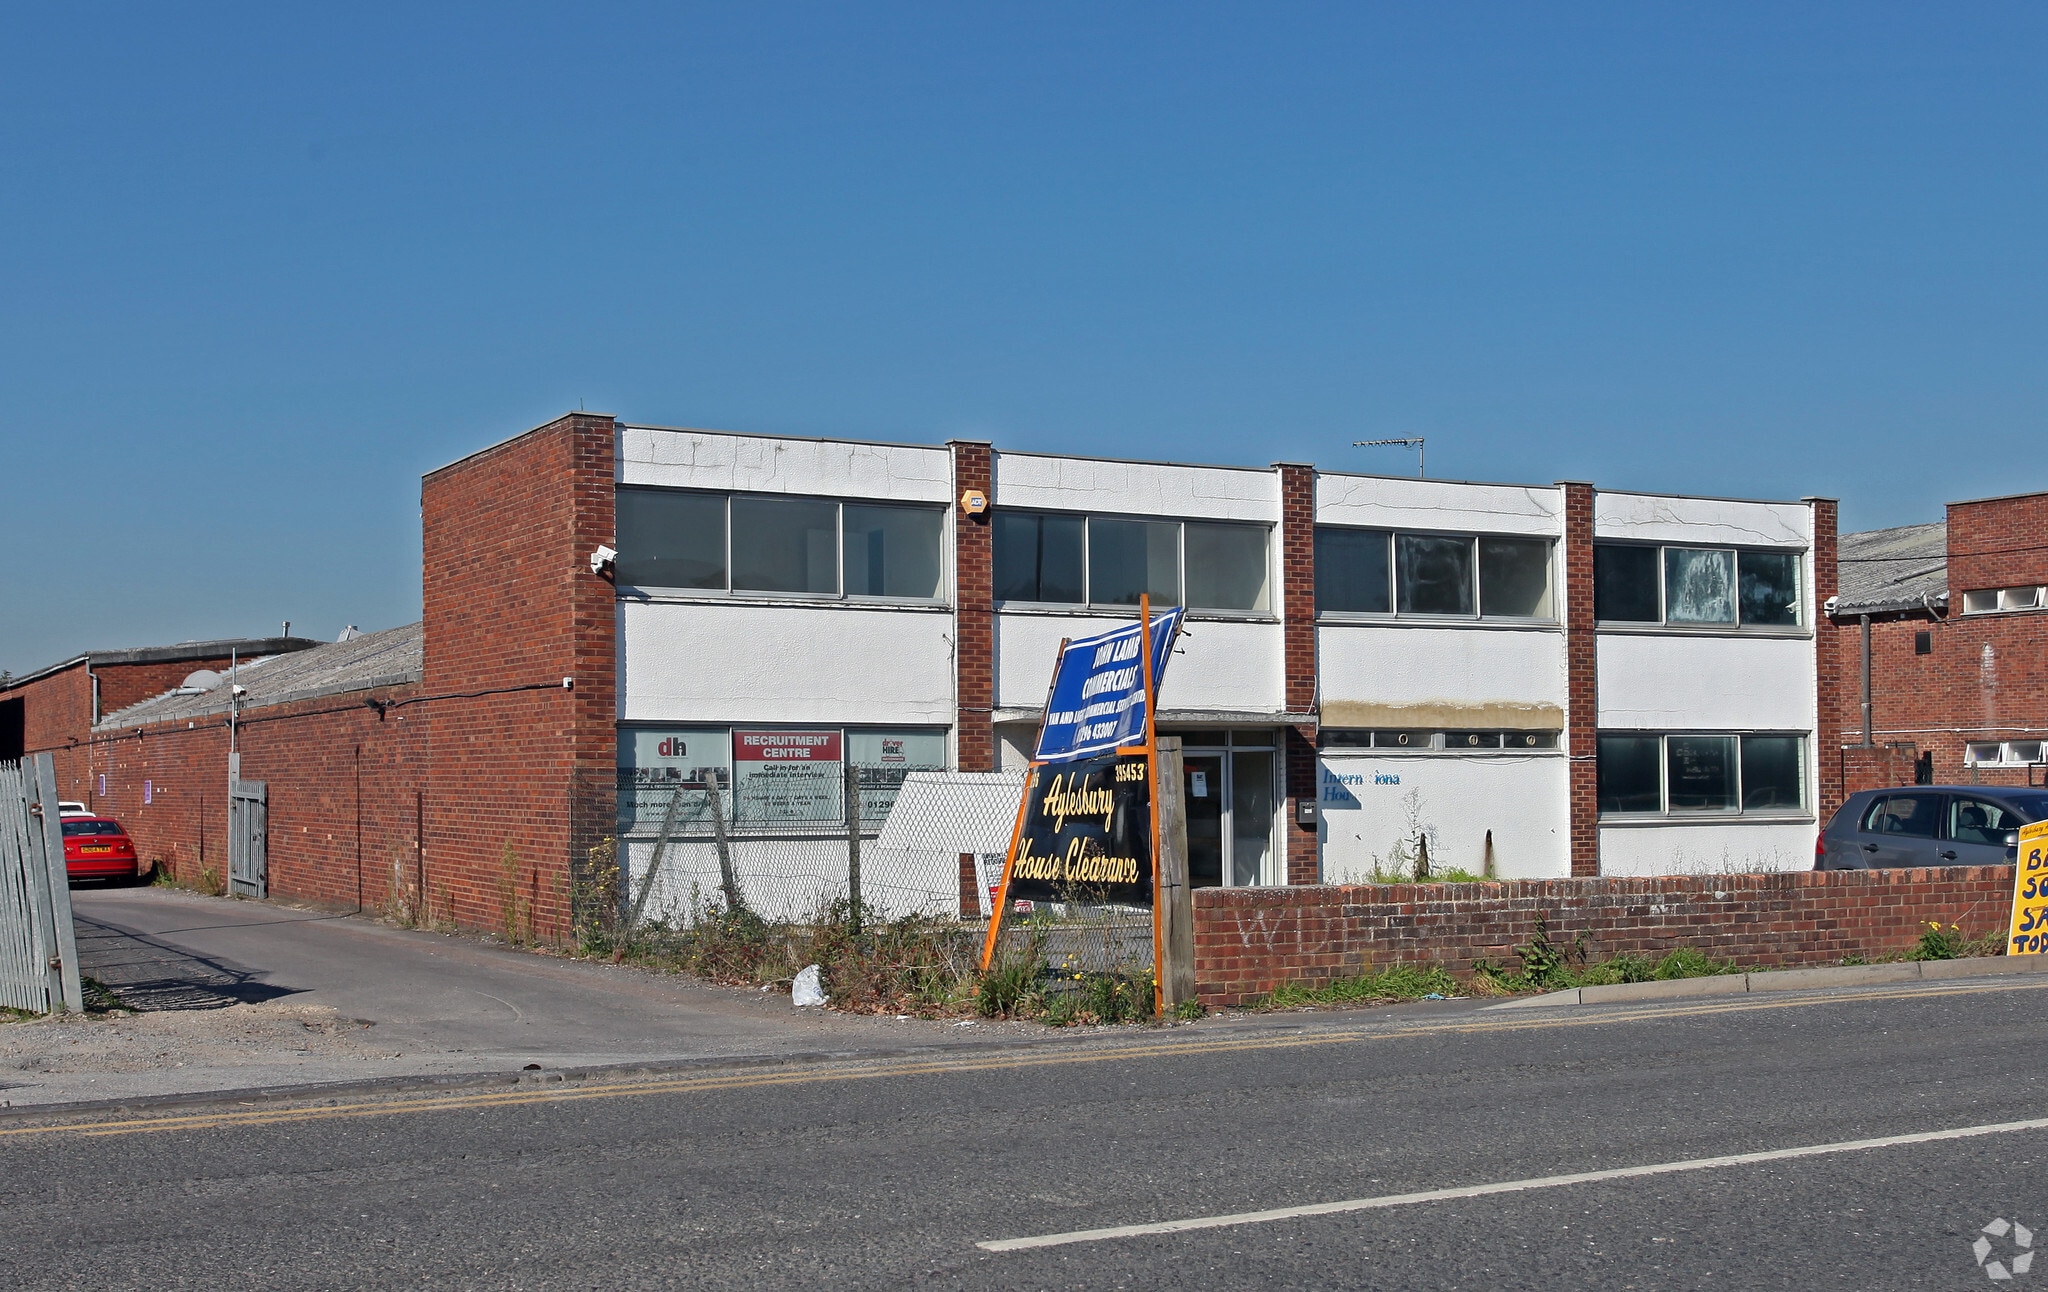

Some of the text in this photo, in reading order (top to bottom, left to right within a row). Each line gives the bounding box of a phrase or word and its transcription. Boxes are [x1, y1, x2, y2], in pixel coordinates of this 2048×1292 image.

[1092, 635, 1141, 669] JOHN LAMB
[1082, 664, 1139, 700] COMMERCIALS
[1059, 711, 1074, 725] AND
[657, 737, 687, 757] dh
[743, 735, 829, 746] RECRUITMENT
[763, 747, 811, 758] CENTRE
[1043, 771, 1115, 834] Aylesbury
[1013, 836, 1139, 884] House Clearance
